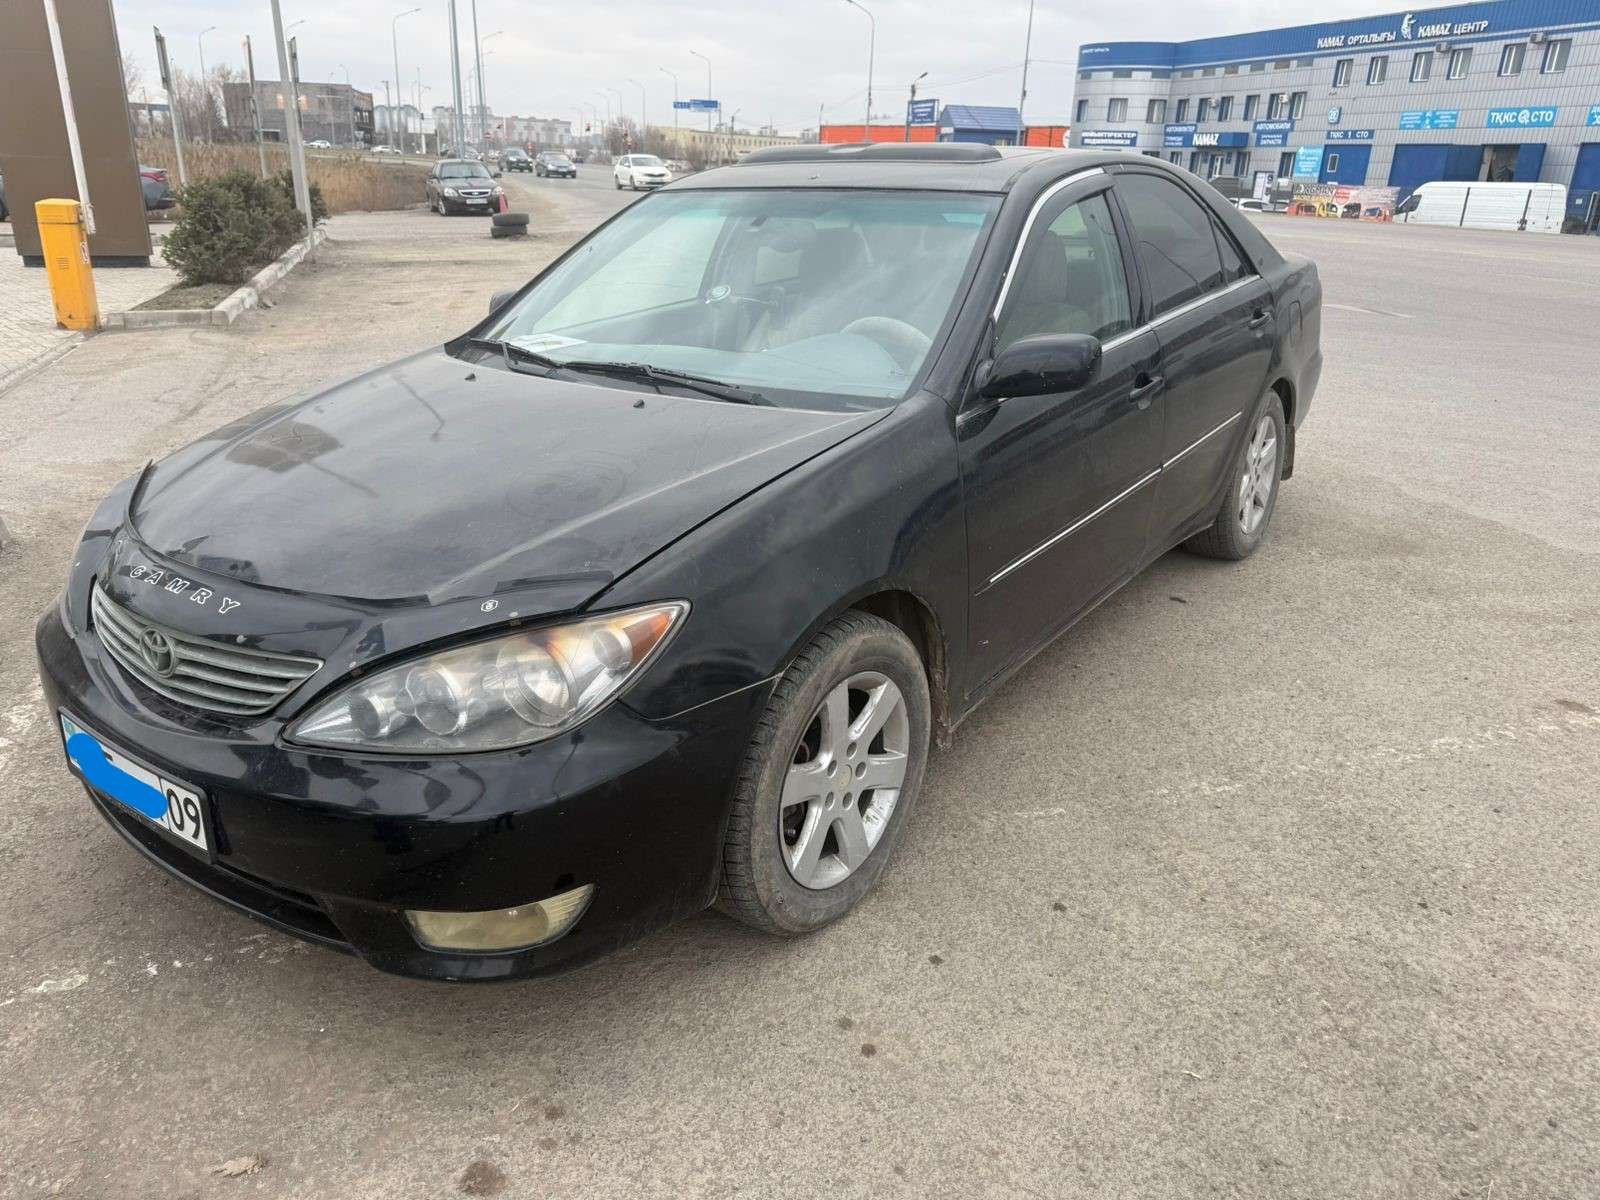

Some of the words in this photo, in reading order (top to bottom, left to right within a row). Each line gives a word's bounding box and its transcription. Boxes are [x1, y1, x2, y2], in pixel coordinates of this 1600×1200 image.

[1418, 23, 1452, 38] KAMAZ
[1453, 20, 1489, 35] ЦЕНТР
[1317, 35, 1345, 48] KAMAZ
[1531, 110, 1553, 123] СТО
[1192, 133, 1220, 147] KAMAZ
[129, 565, 241, 614] CAMRY
[166, 788, 201, 840] 09
